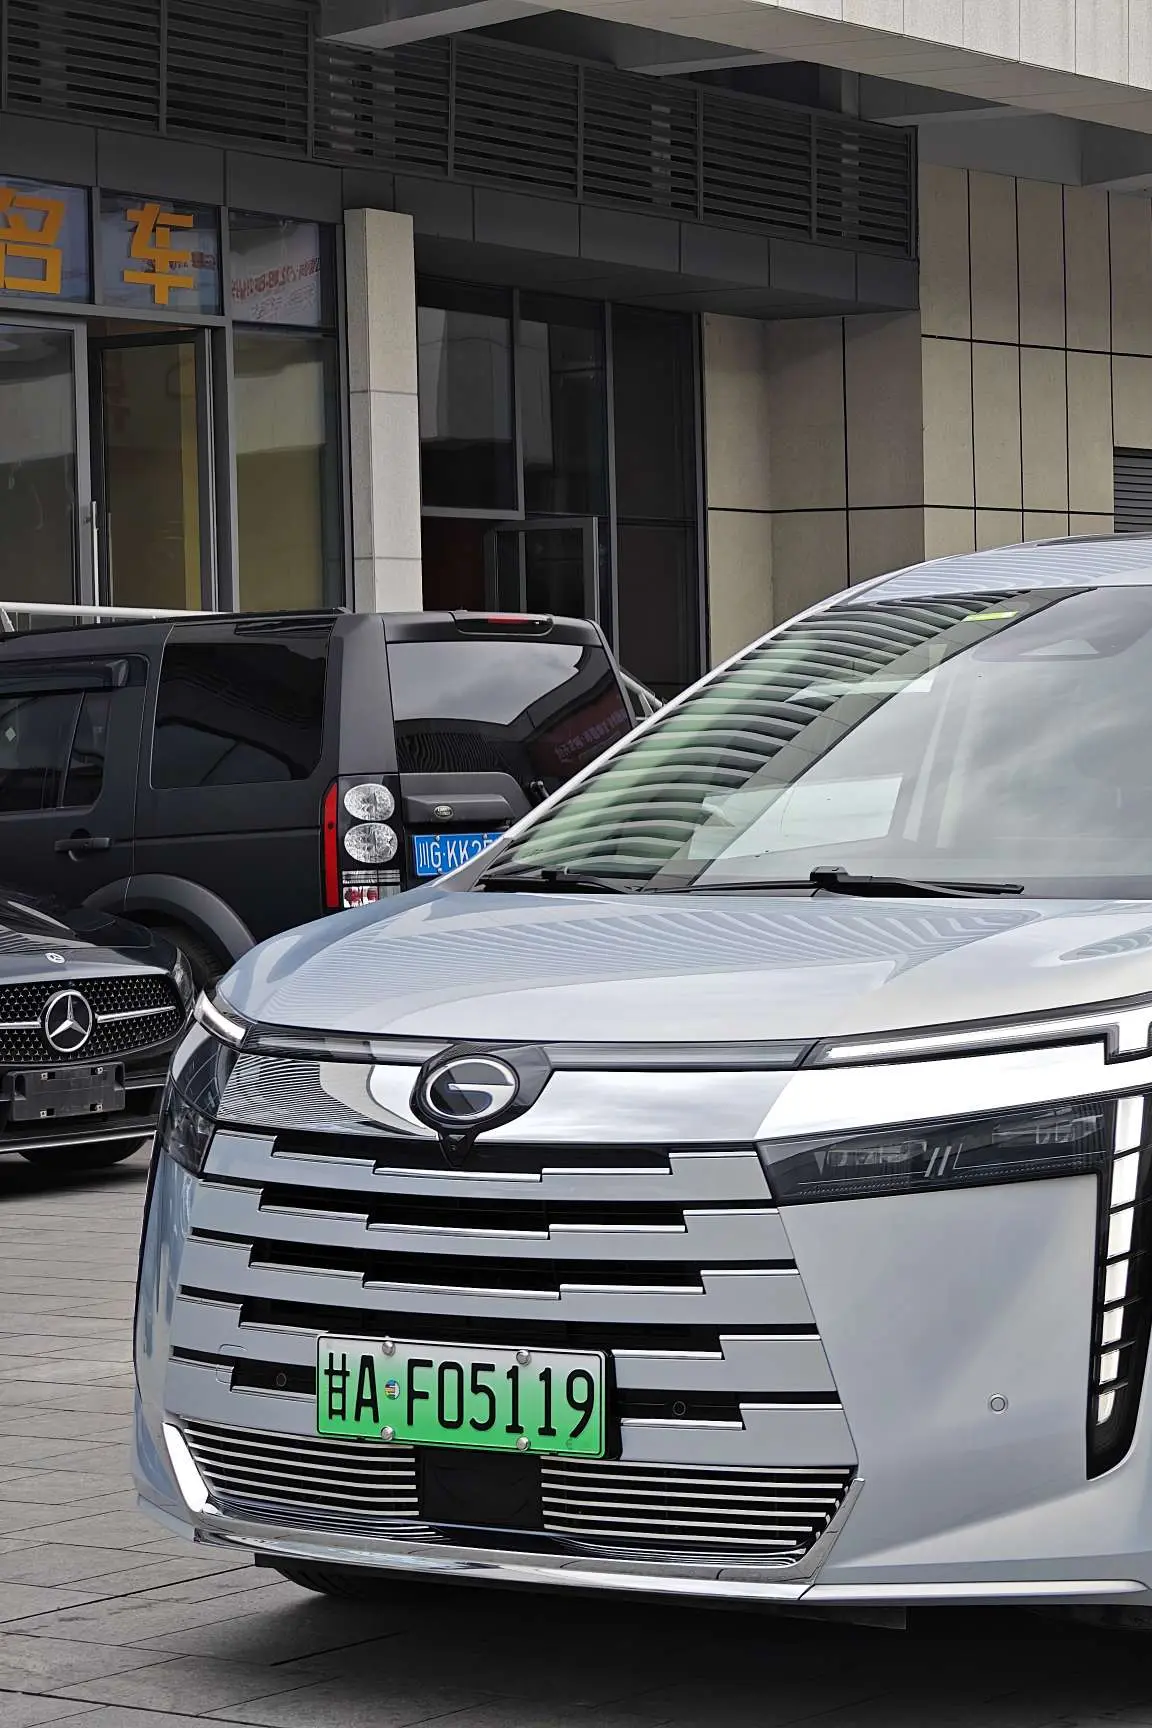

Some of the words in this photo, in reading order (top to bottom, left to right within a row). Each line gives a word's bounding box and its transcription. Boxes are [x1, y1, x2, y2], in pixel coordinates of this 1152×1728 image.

[419, 839, 494, 868] 川G·KK2
[324, 1352, 380, 1423] 甘A
[406, 1358, 596, 1439] F05119
